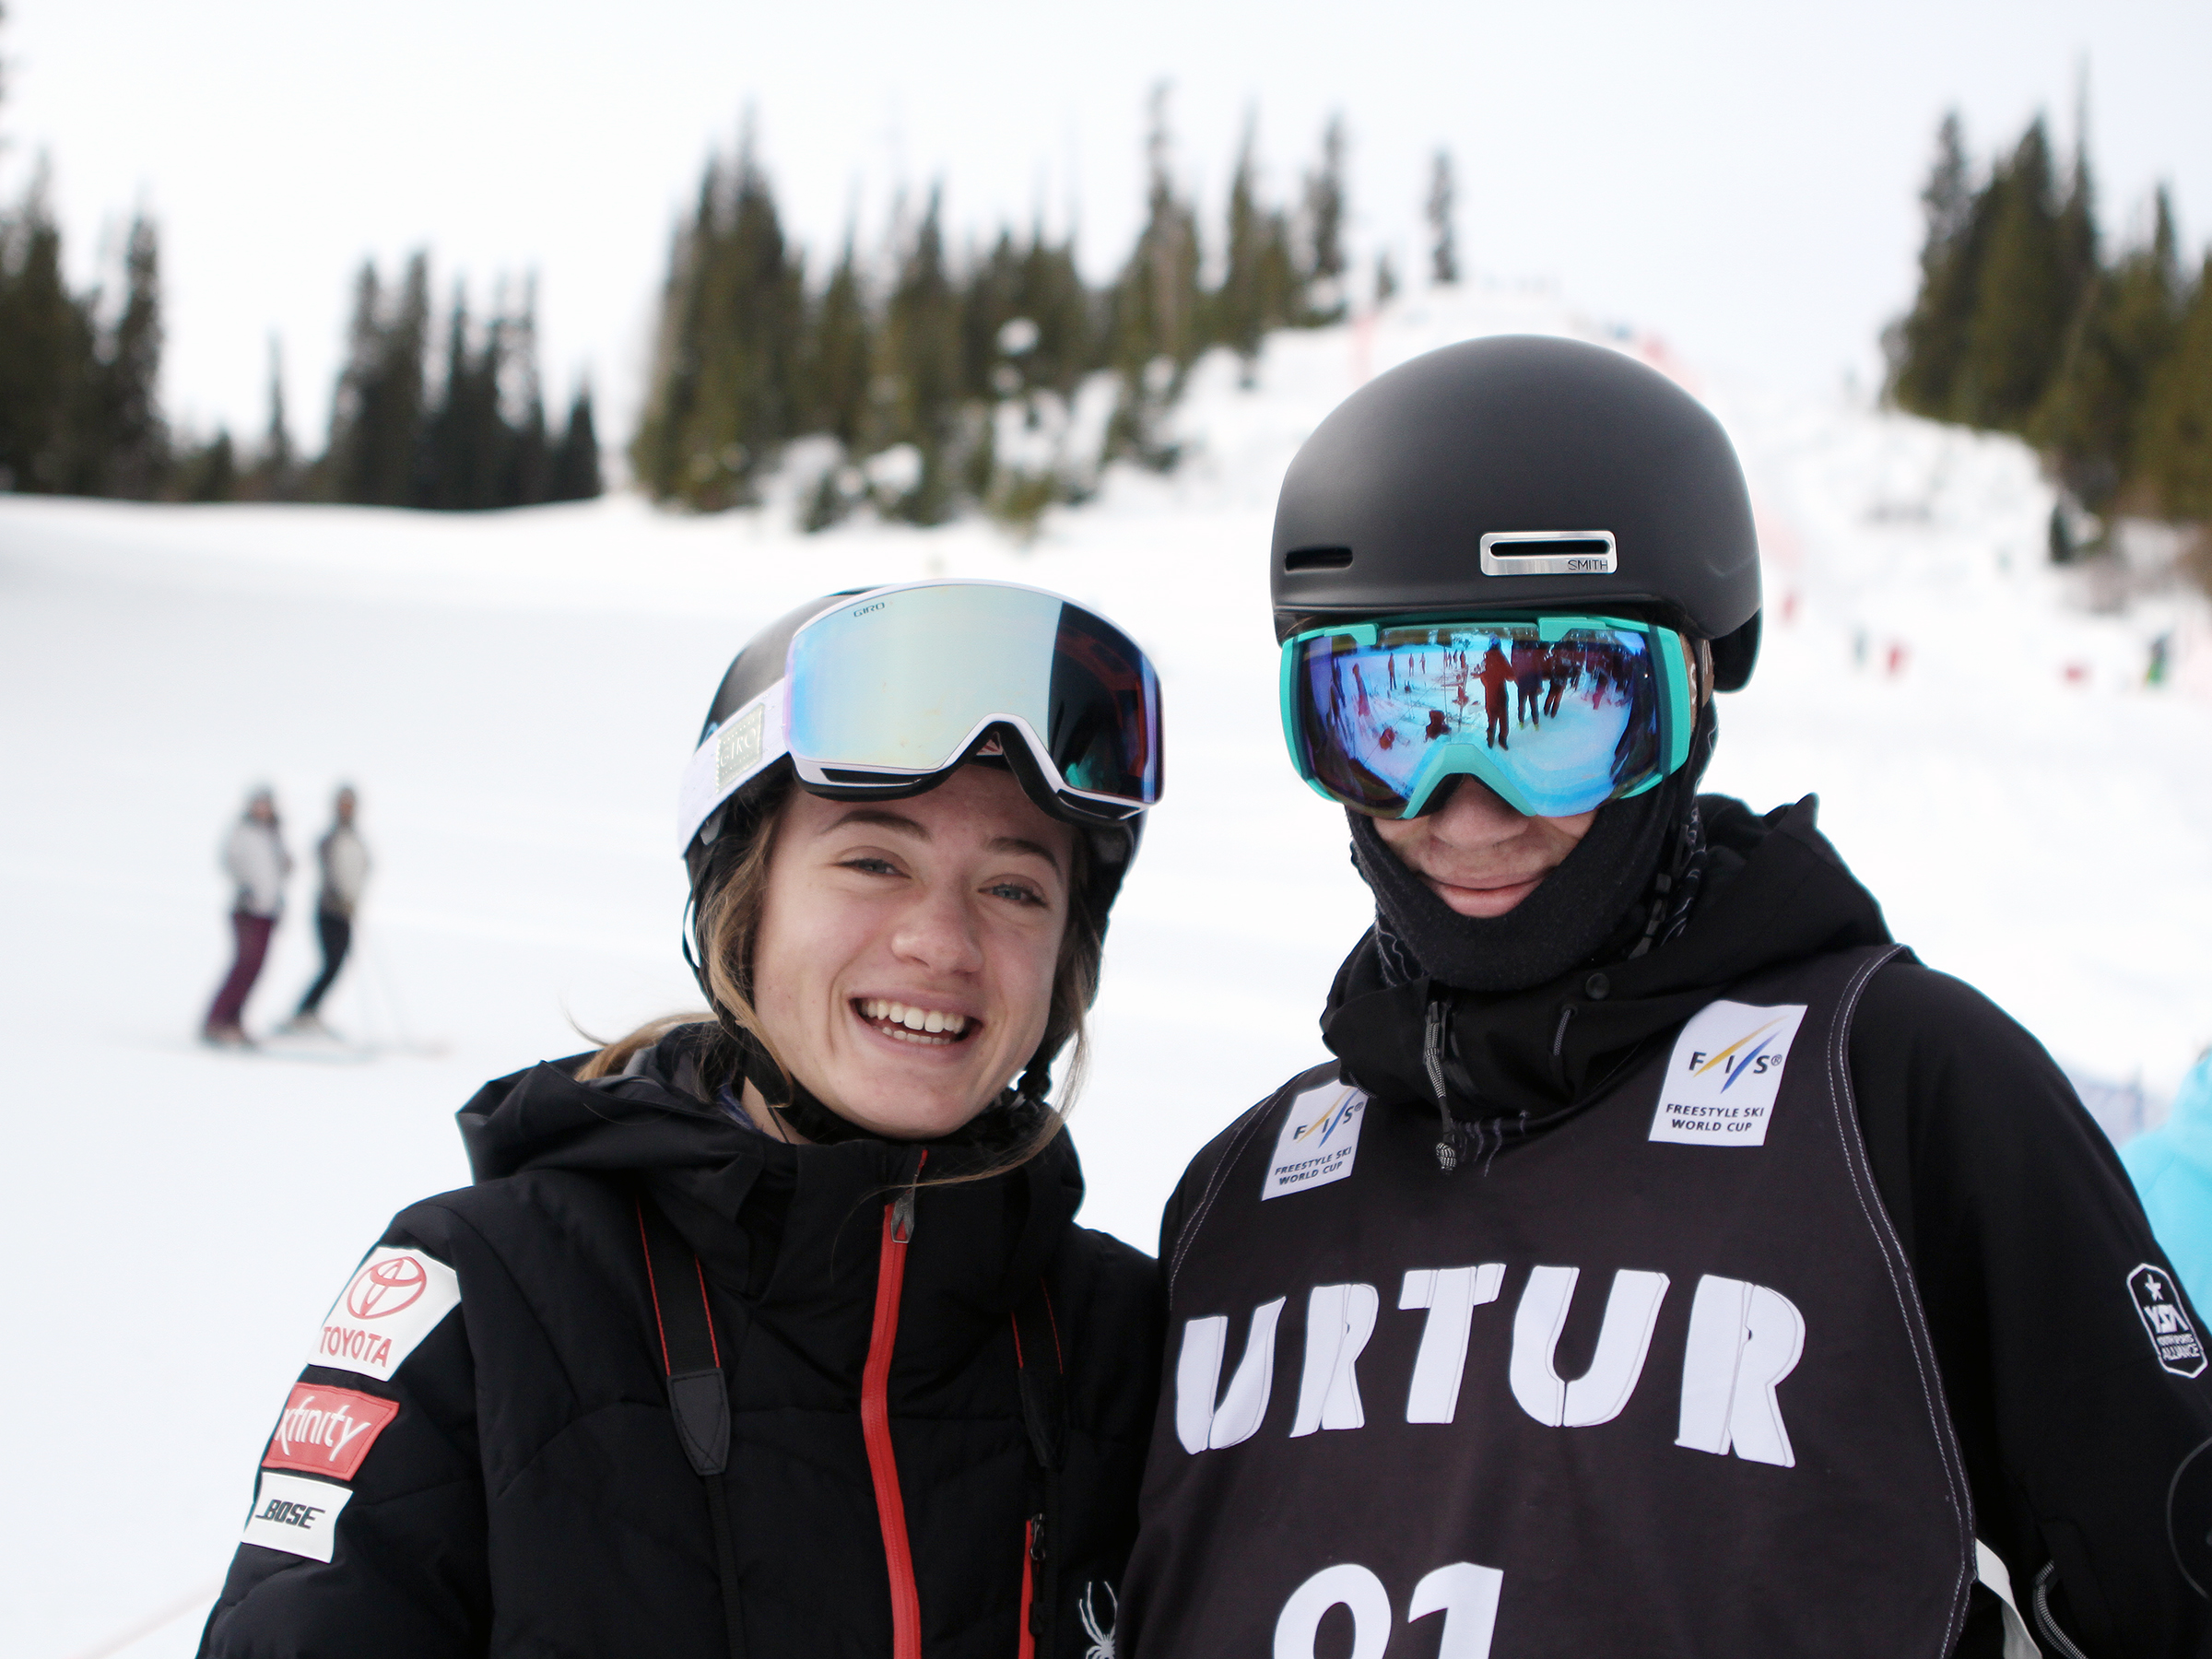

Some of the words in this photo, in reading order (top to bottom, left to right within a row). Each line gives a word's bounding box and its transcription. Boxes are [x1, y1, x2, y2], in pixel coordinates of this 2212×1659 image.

[1568, 559, 1608, 571] SMITH
[853, 602, 886, 618] GIRO
[1665, 1103, 1740, 1118] FREESTYLE
[1743, 1107, 1765, 1117] SKI
[1672, 1118, 1722, 1132] WORLD
[1726, 1122, 1753, 1132] CUP
[1275, 1153, 1334, 1176] FREESTYLE
[1335, 1146, 1352, 1160] SKI
[1278, 1169, 1319, 1186] WORLD
[1322, 1160, 1343, 1175] CUP
[319, 1325, 393, 1369] TOYOTA
[1175, 1263, 1806, 1468] URTUR
[254, 1499, 326, 1530] BOSE
